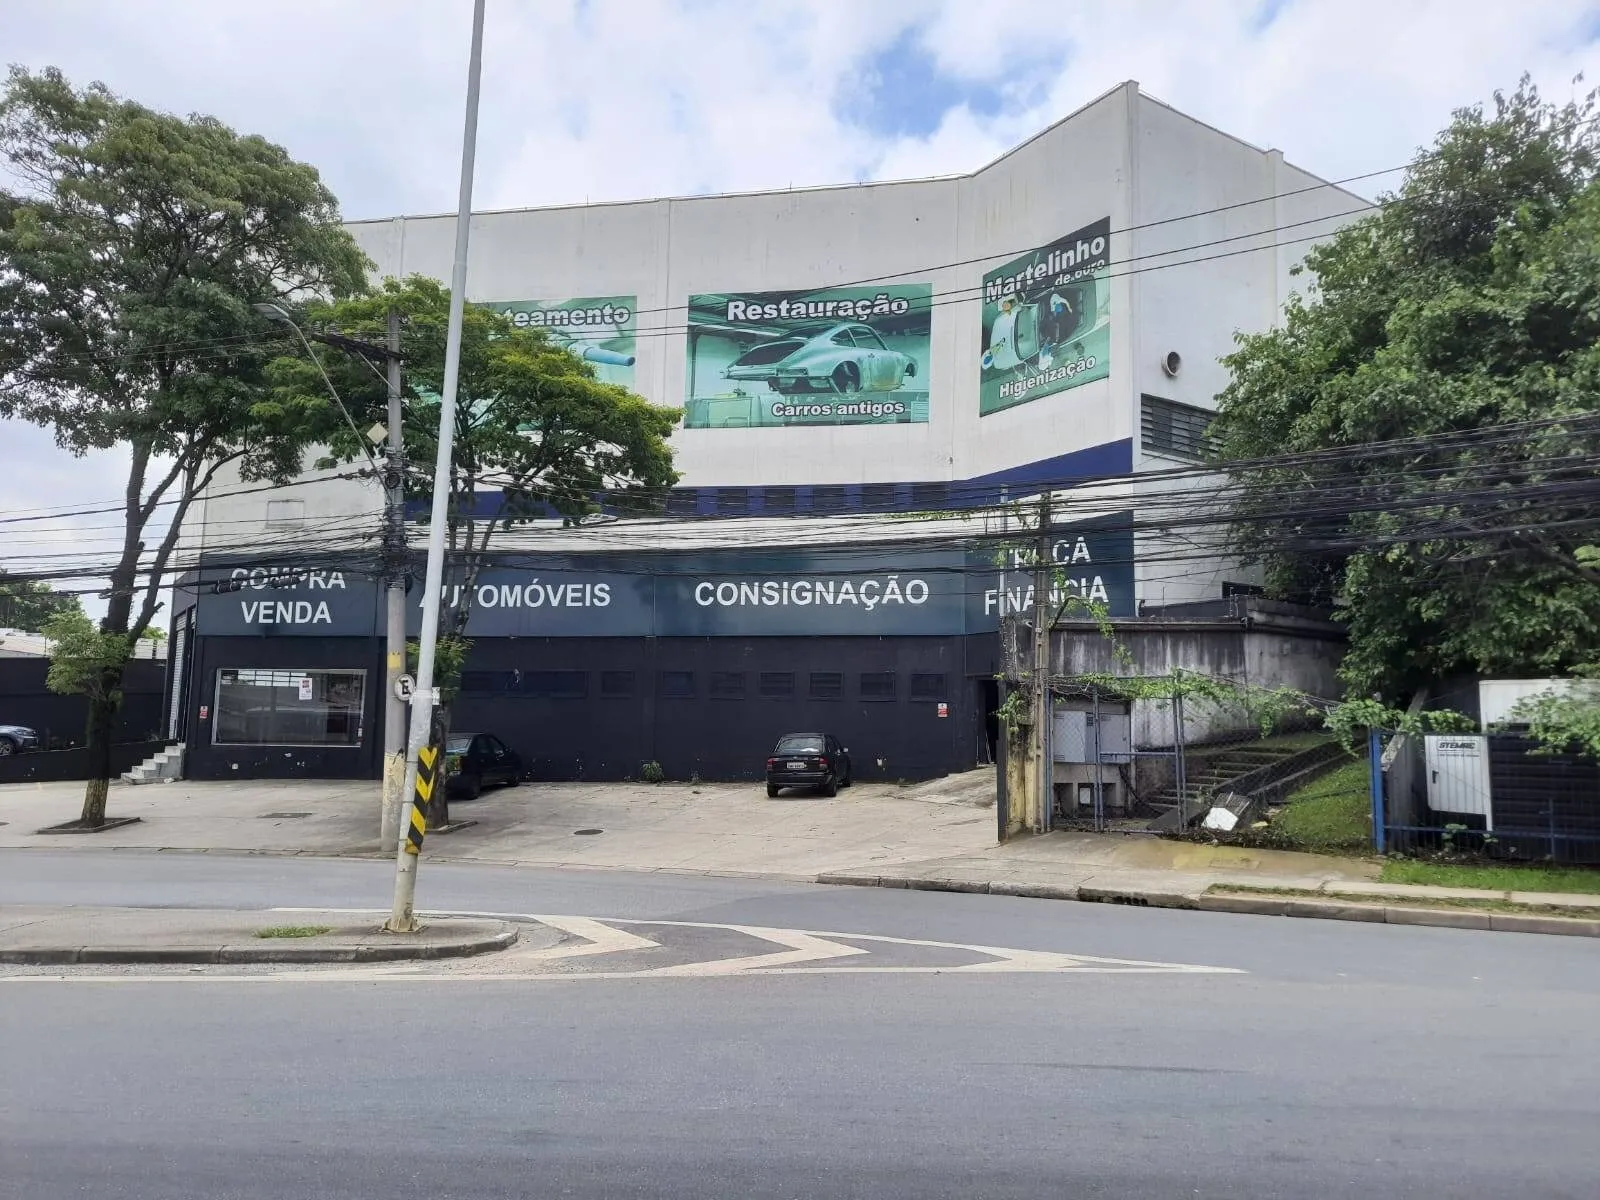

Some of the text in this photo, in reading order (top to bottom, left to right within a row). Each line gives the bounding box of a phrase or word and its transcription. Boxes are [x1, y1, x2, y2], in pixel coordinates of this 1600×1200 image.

[985, 236, 1105, 304] Martelinho
[1055, 259, 1105, 286] de ouro
[727, 294, 909, 321] Restauração
[999, 355, 1097, 399] Higienização
[772, 401, 905, 418] Carros antigos
[419, 578, 611, 608] UOMÓVEIS
[695, 575, 929, 610] CONSIGNAÇÃO
[241, 601, 333, 624] VENDA
